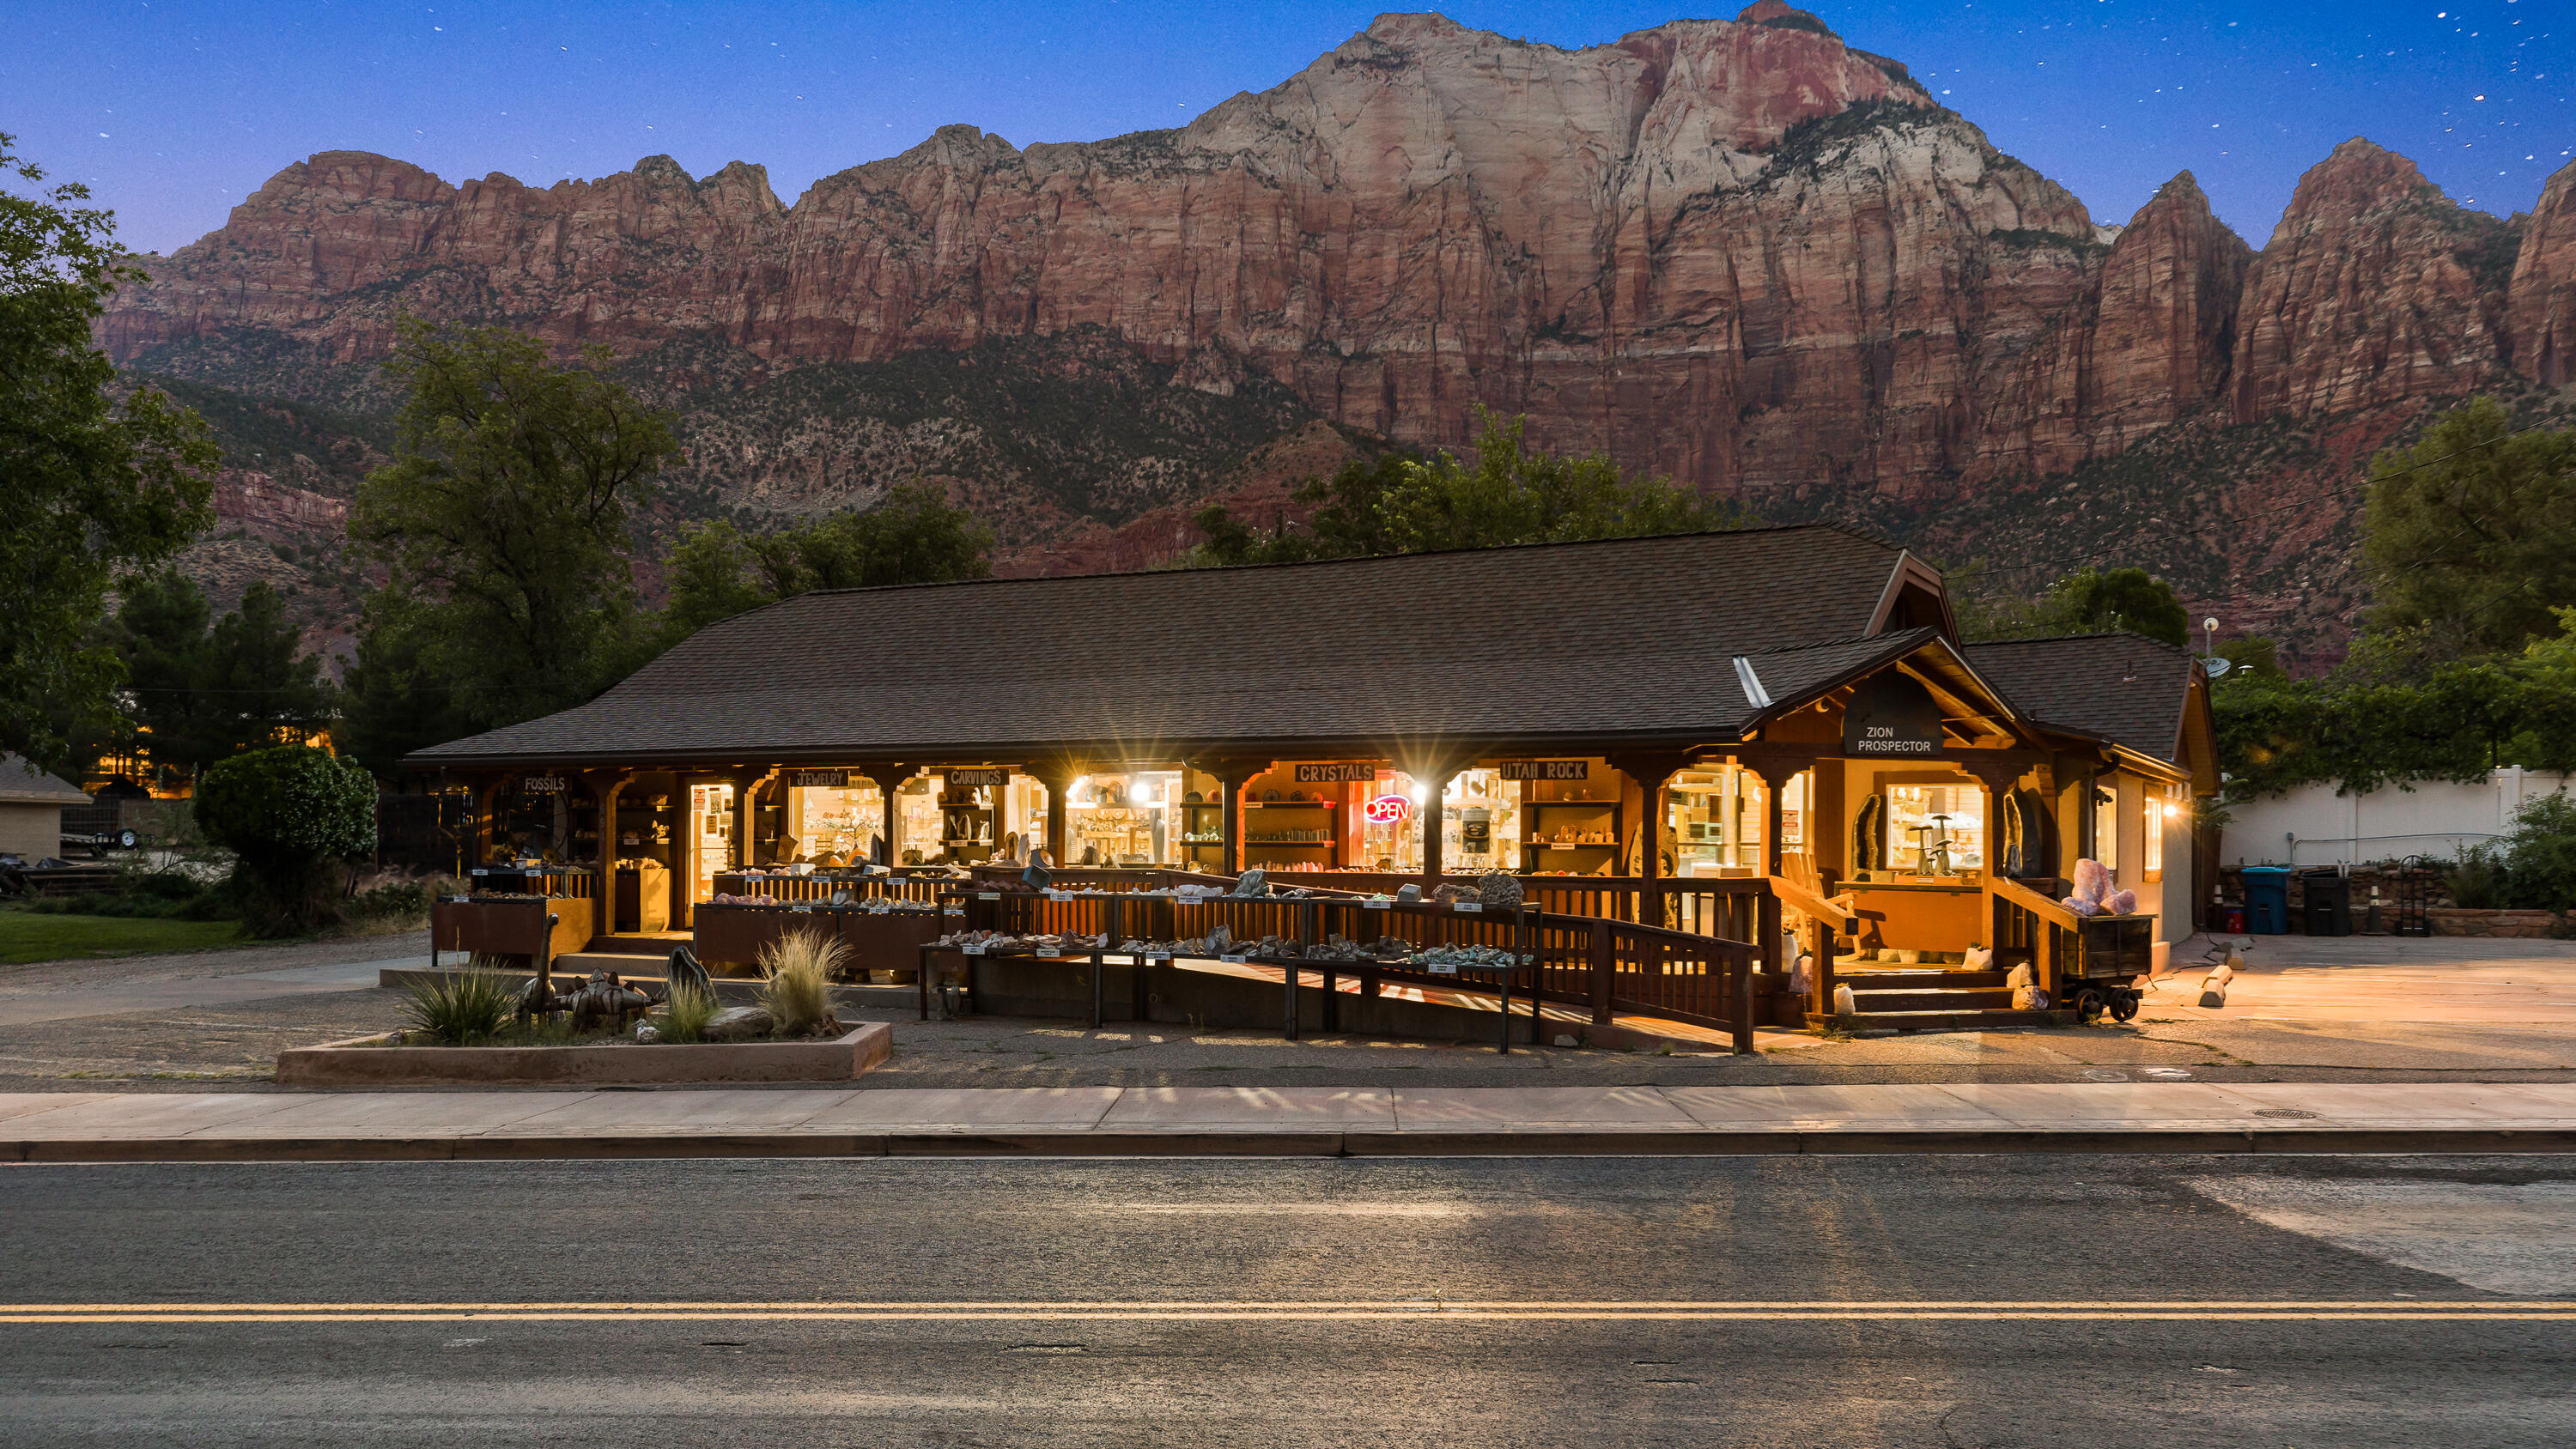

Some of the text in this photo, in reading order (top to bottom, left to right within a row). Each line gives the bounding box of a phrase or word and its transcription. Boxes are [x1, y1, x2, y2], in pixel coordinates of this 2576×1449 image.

[1867, 727, 1893, 737] ZION
[1858, 741, 1930, 751] PROSPECTOR
[951, 770, 1001, 785] CARVINGS
[1300, 765, 1372, 781] CRYSTALS
[1502, 762, 1584, 779] UTAH ROCK
[525, 777, 565, 791] FOSSILS
[798, 773, 842, 785] JEWELRY
[1364, 801, 1408, 818] OPEN
